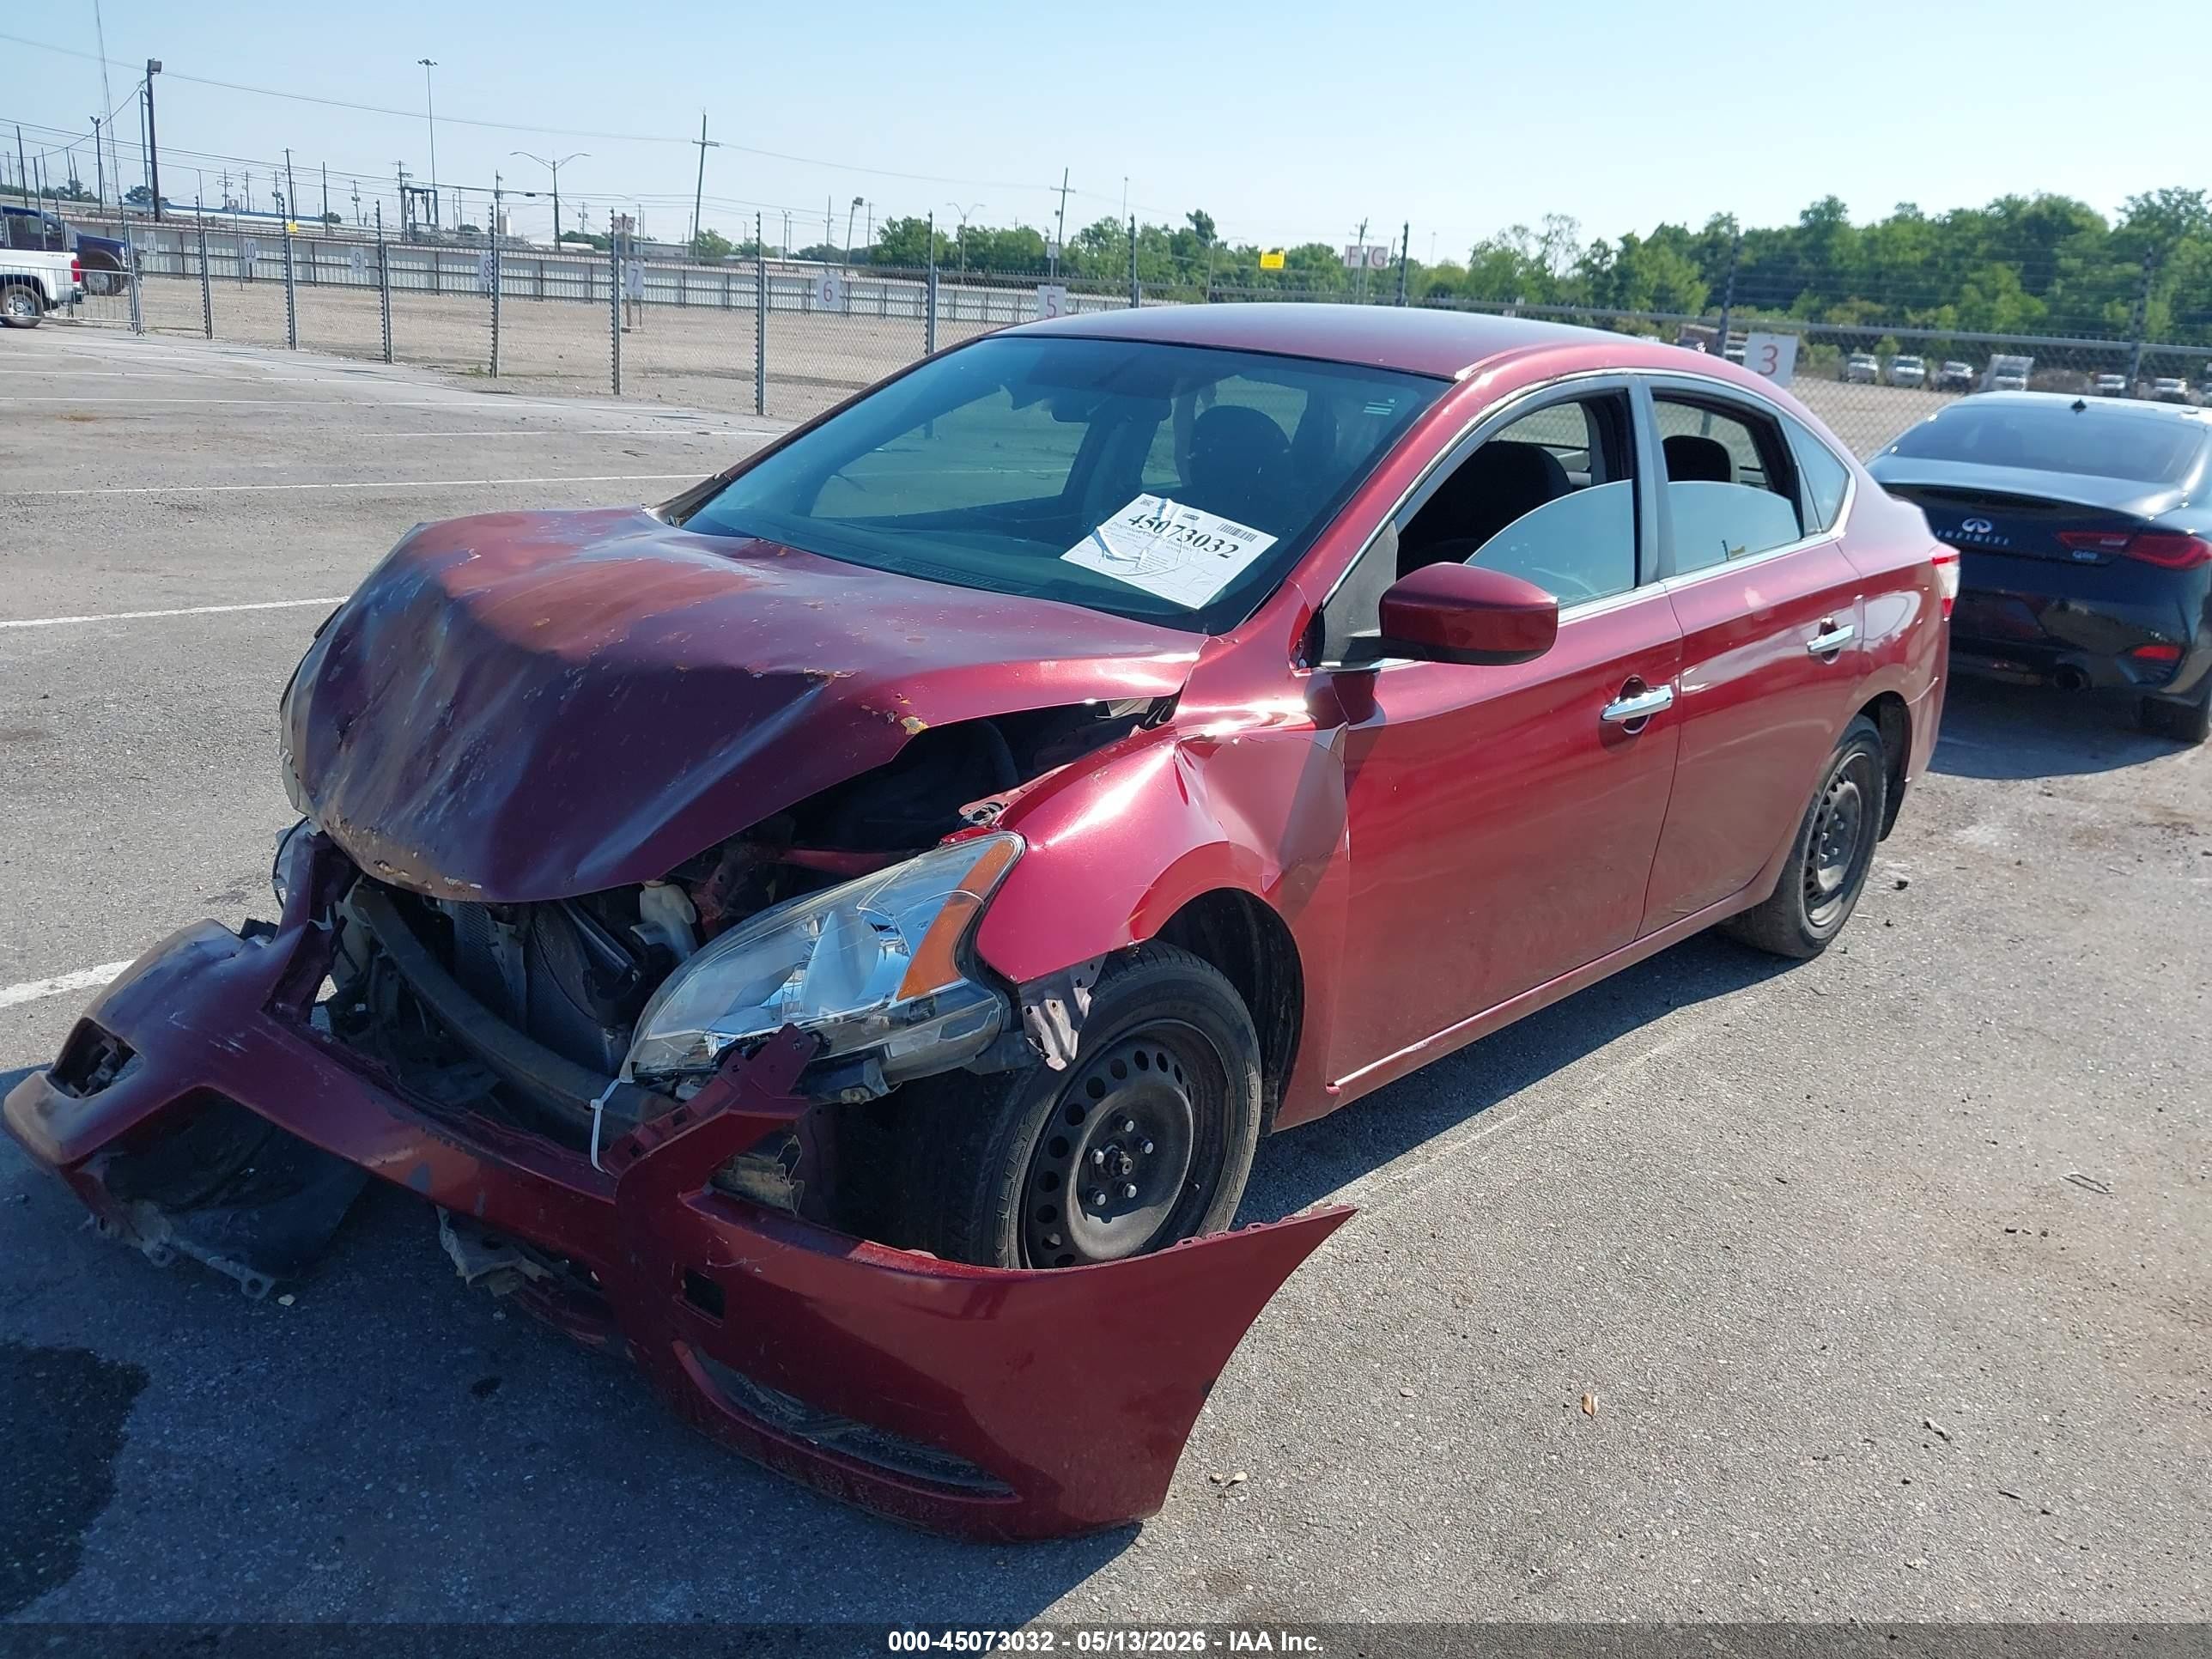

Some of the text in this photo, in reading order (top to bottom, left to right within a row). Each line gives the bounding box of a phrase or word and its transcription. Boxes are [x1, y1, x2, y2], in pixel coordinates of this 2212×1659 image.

[245, 241, 256, 258] 10
[1347, 246, 1357, 266] F
[1370, 246, 1386, 267] G
[355, 252, 362, 269] 9
[483, 260, 490, 278] 8
[630, 269, 639, 288] 7
[823, 281, 833, 302] 6
[1045, 295, 1056, 318] 5
[1757, 343, 1778, 376] 3
[1127, 513, 1239, 559] 45073032
